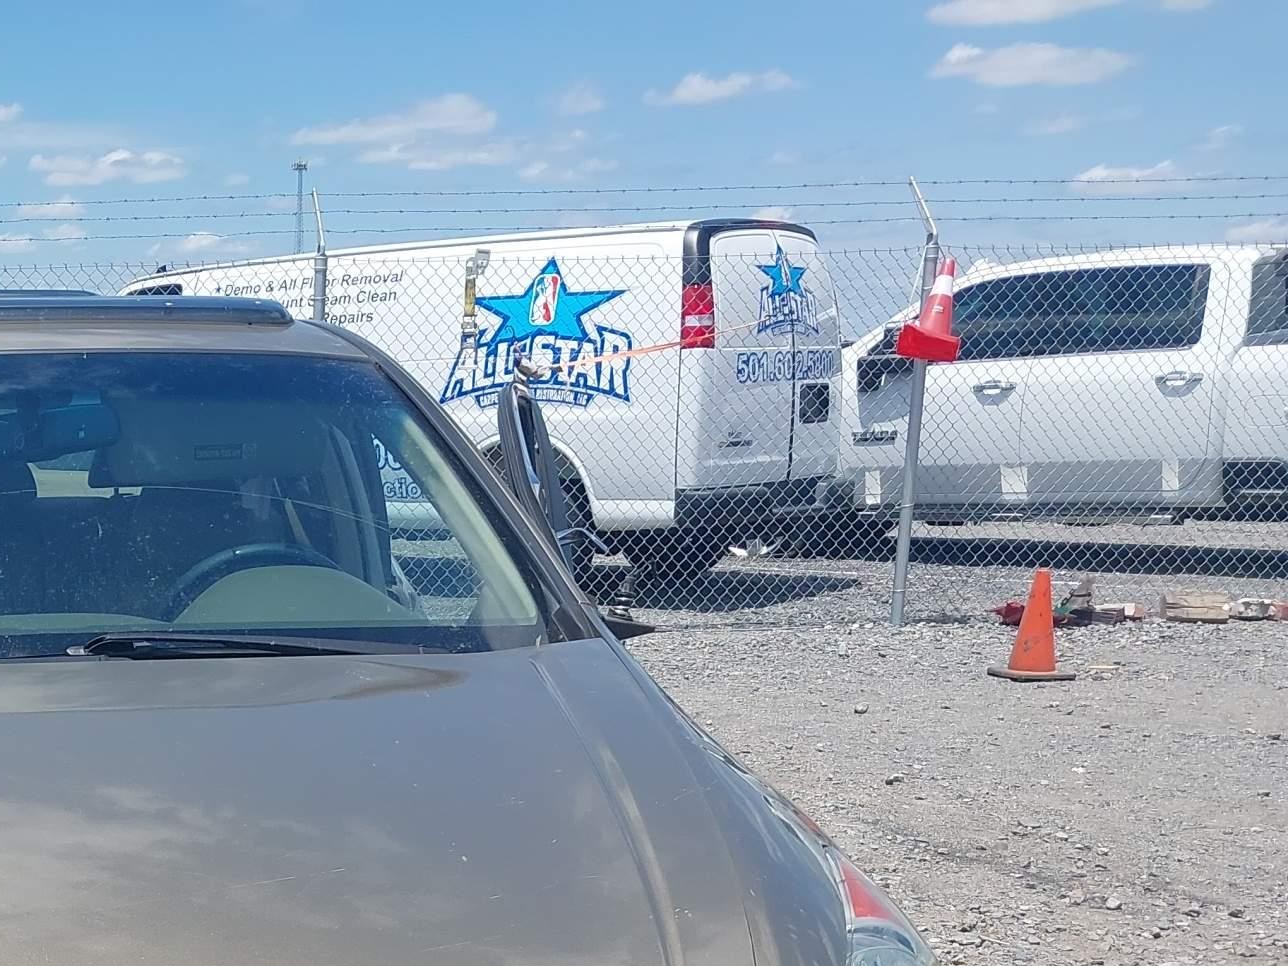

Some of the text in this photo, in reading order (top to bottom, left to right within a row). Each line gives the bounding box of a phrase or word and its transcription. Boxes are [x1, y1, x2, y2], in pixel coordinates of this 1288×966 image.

[225, 270, 405, 297] Demo & All Flor Removal
[308, 294, 351, 307] Seam
[357, 290, 398, 304] Clean
[323, 311, 374, 326] Repairs
